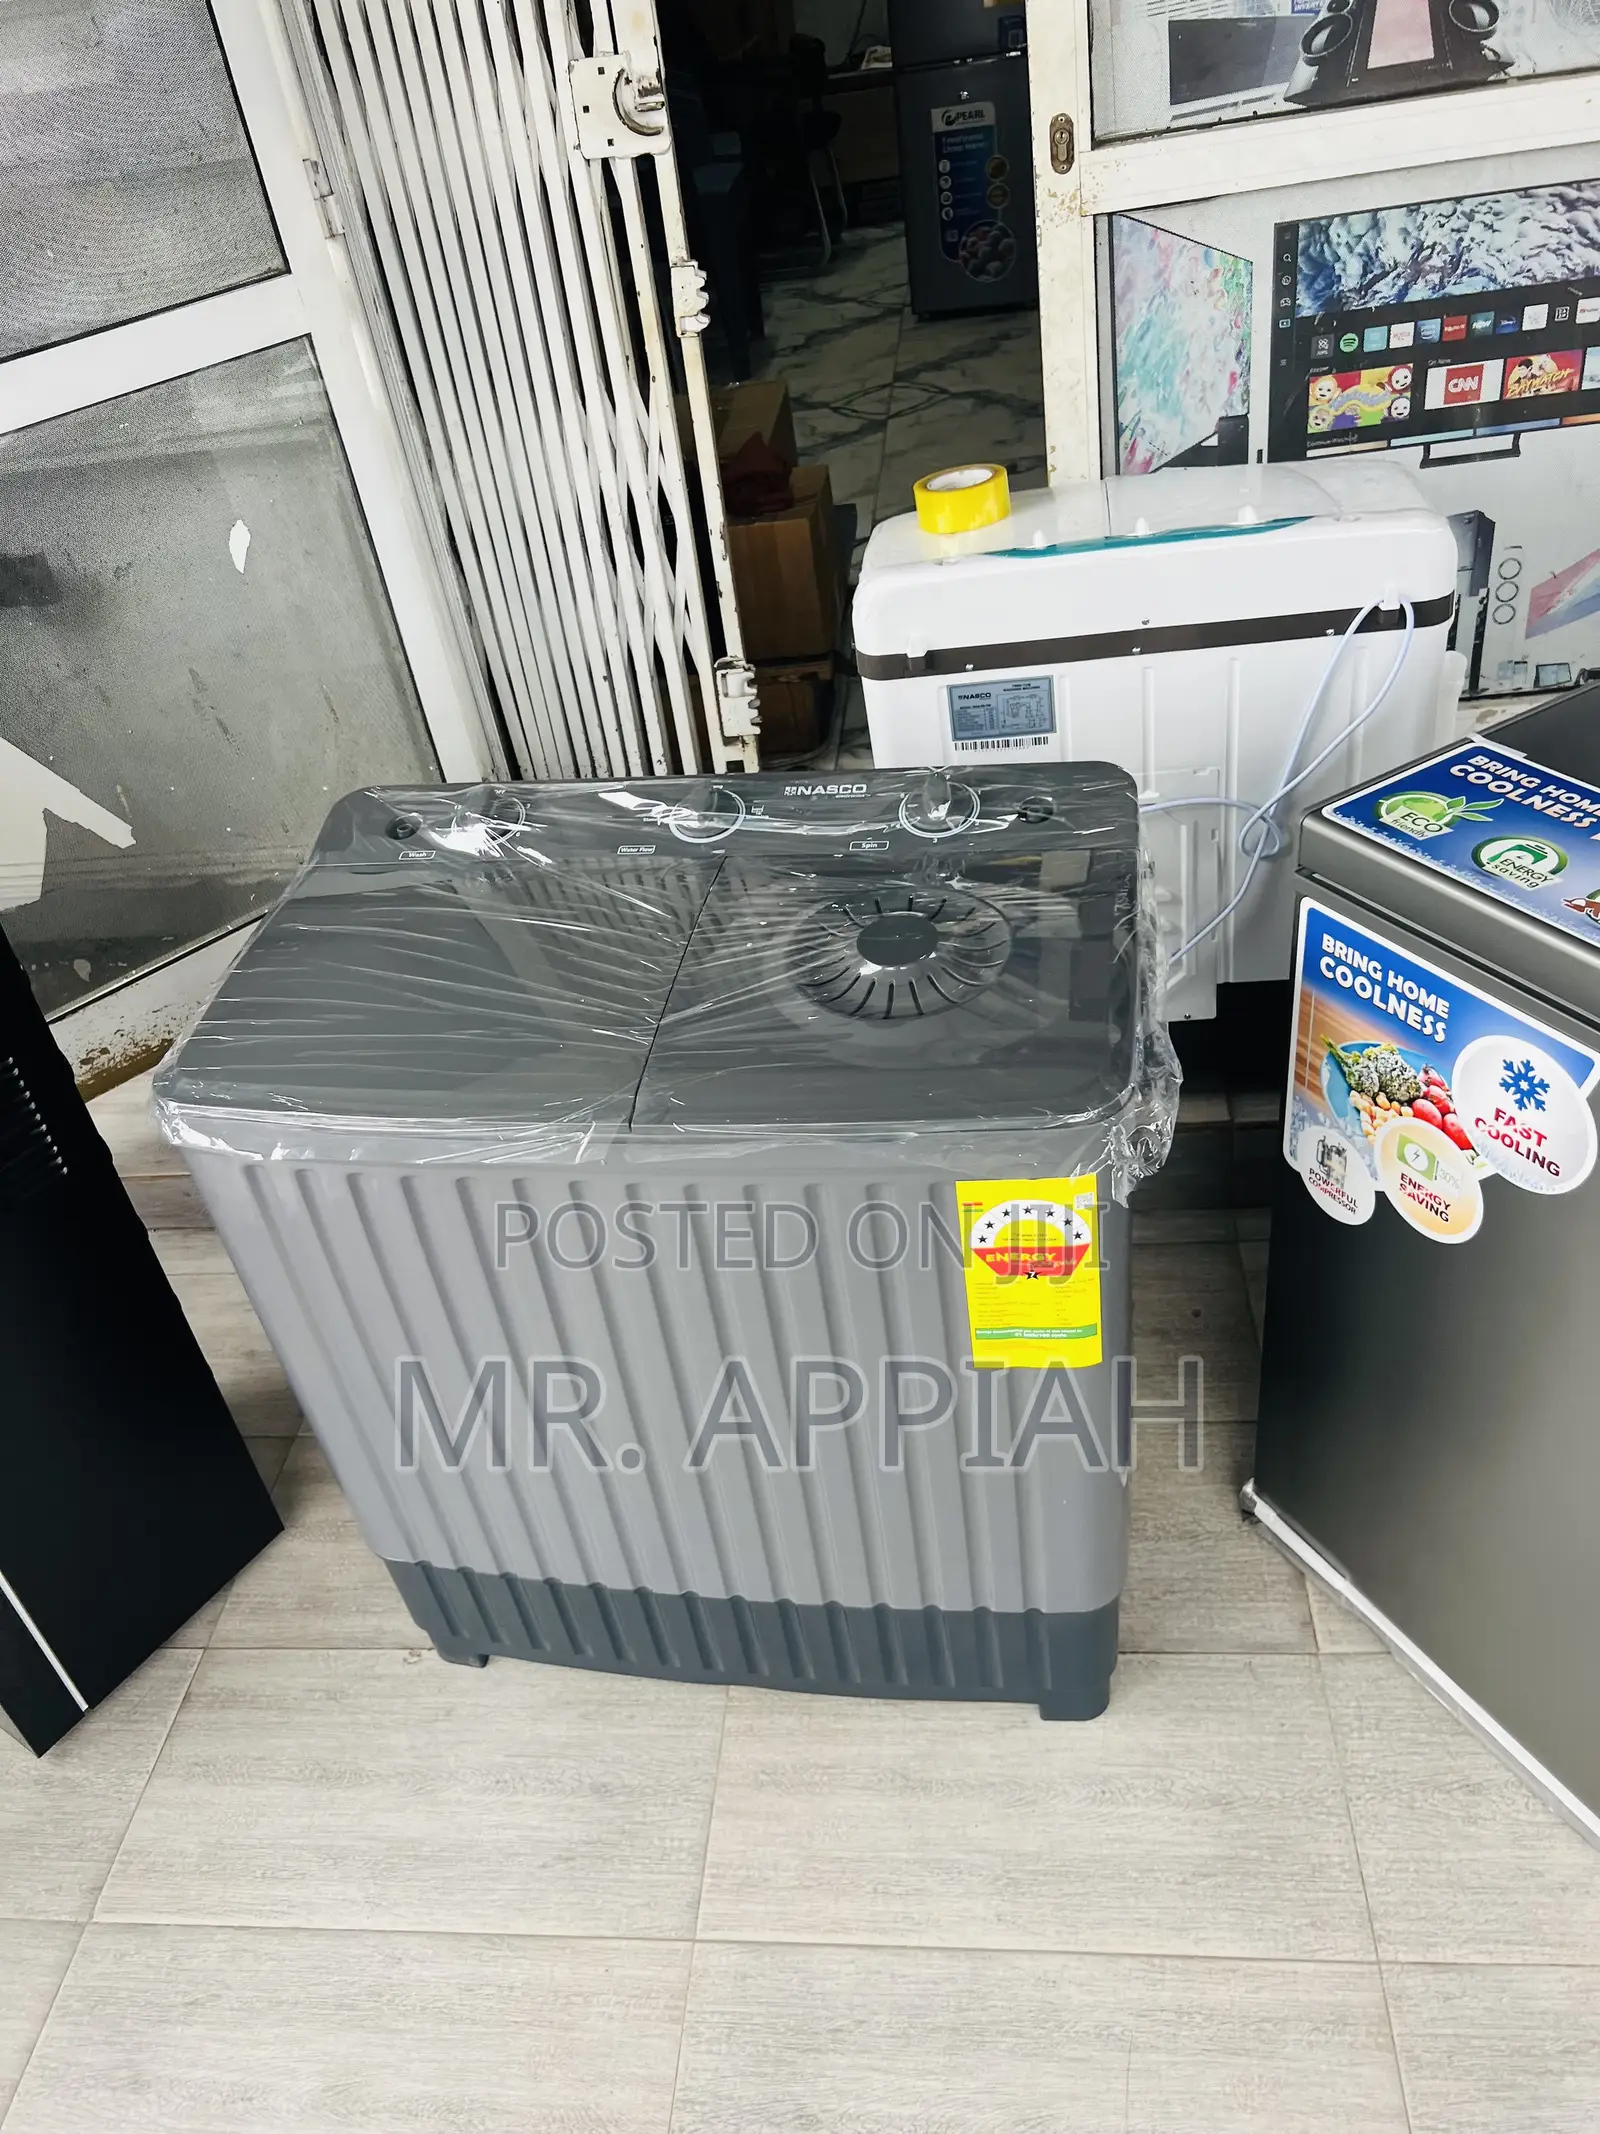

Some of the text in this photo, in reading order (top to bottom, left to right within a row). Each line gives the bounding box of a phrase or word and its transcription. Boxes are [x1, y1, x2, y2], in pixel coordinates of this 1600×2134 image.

[956, 109, 986, 121] PEARL
[1448, 376, 1479, 393] CNN
[962, 692, 992, 700] NASCO
[1467, 755, 1541, 788] BRING
[797, 784, 867, 795] NASCO
[1450, 764, 1598, 829] COOLNESS
[1390, 818, 1430, 840] friendly
[1400, 811, 1443, 833] ECO
[861, 842, 878, 850] Spin
[1491, 863, 1540, 889] saving
[1500, 857, 1554, 884] ENERGY
[1322, 933, 1450, 1020] BRING HOME
[1319, 955, 1447, 1043] COOLNESS
[1494, 1106, 1548, 1148] FAST
[1474, 1117, 1561, 1178] COOLING
[1308, 1176, 1357, 1215] COMPRESSOR
[1309, 1167, 1359, 1208] POWERFUL
[1399, 1182, 1450, 1223] SAVING
[1400, 1172, 1451, 1211] ENERGY
[986, 1252, 1057, 1263] ENERGY
